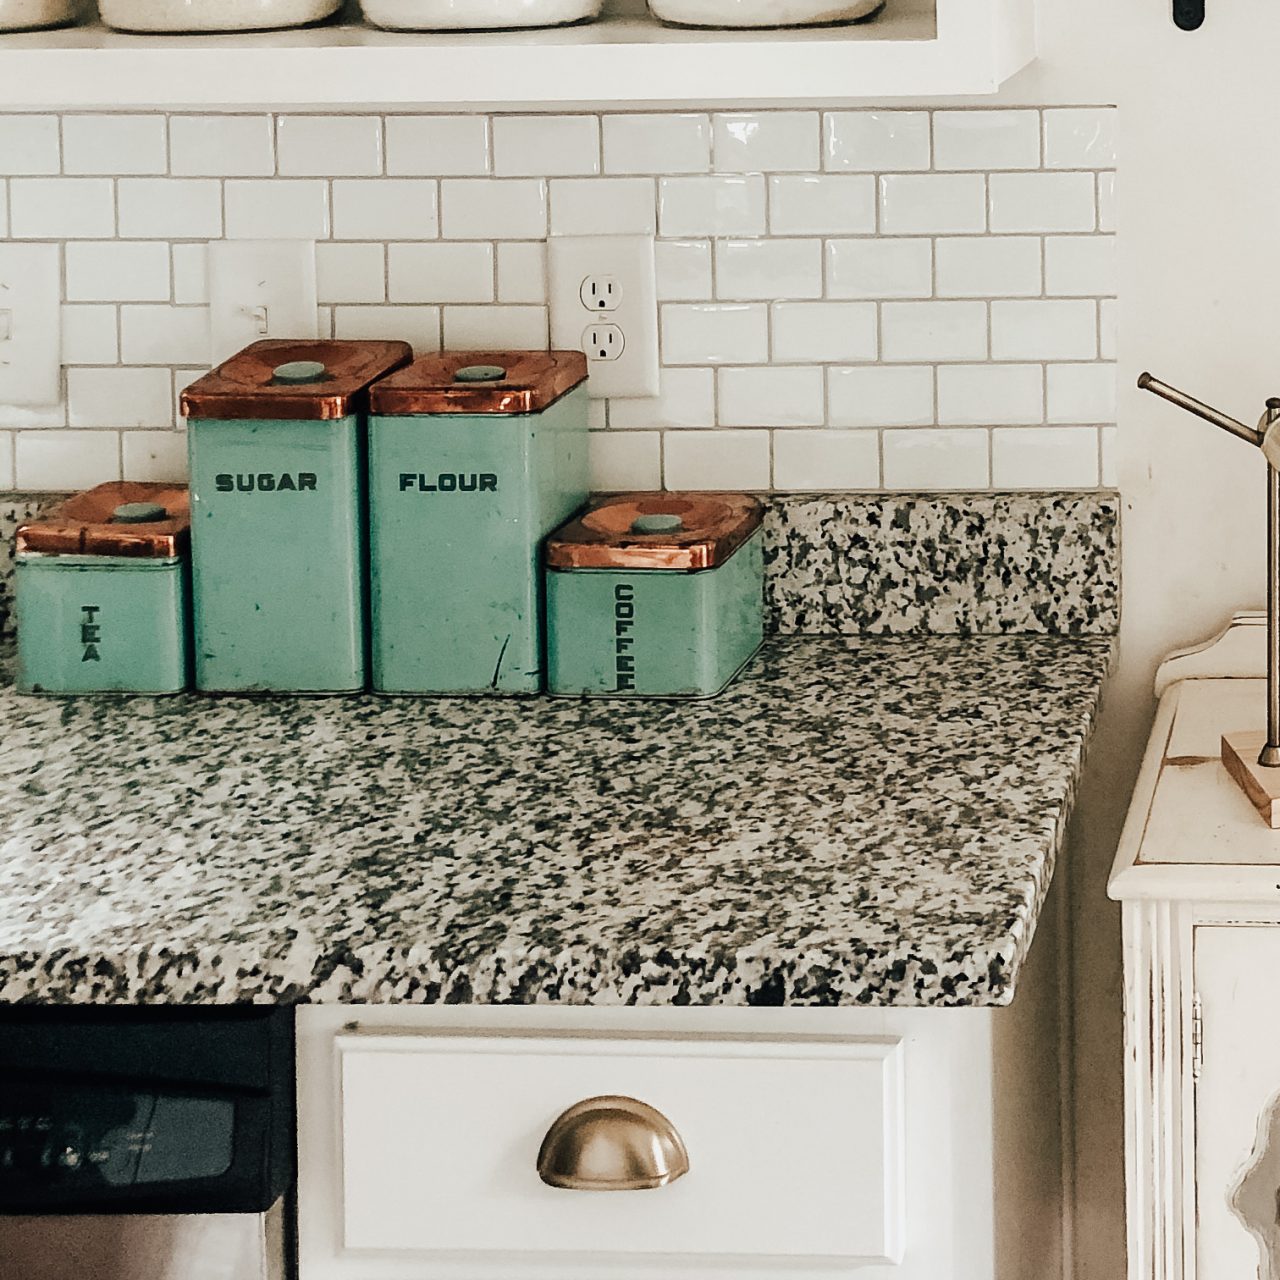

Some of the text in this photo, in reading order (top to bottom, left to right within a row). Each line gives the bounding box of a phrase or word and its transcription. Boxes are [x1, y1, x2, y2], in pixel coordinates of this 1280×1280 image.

[215, 472, 318, 492] SUGAR
[400, 473, 498, 492] FLOUR
[81, 605, 100, 663] TEA
[614, 584, 635, 691] COFFEE
